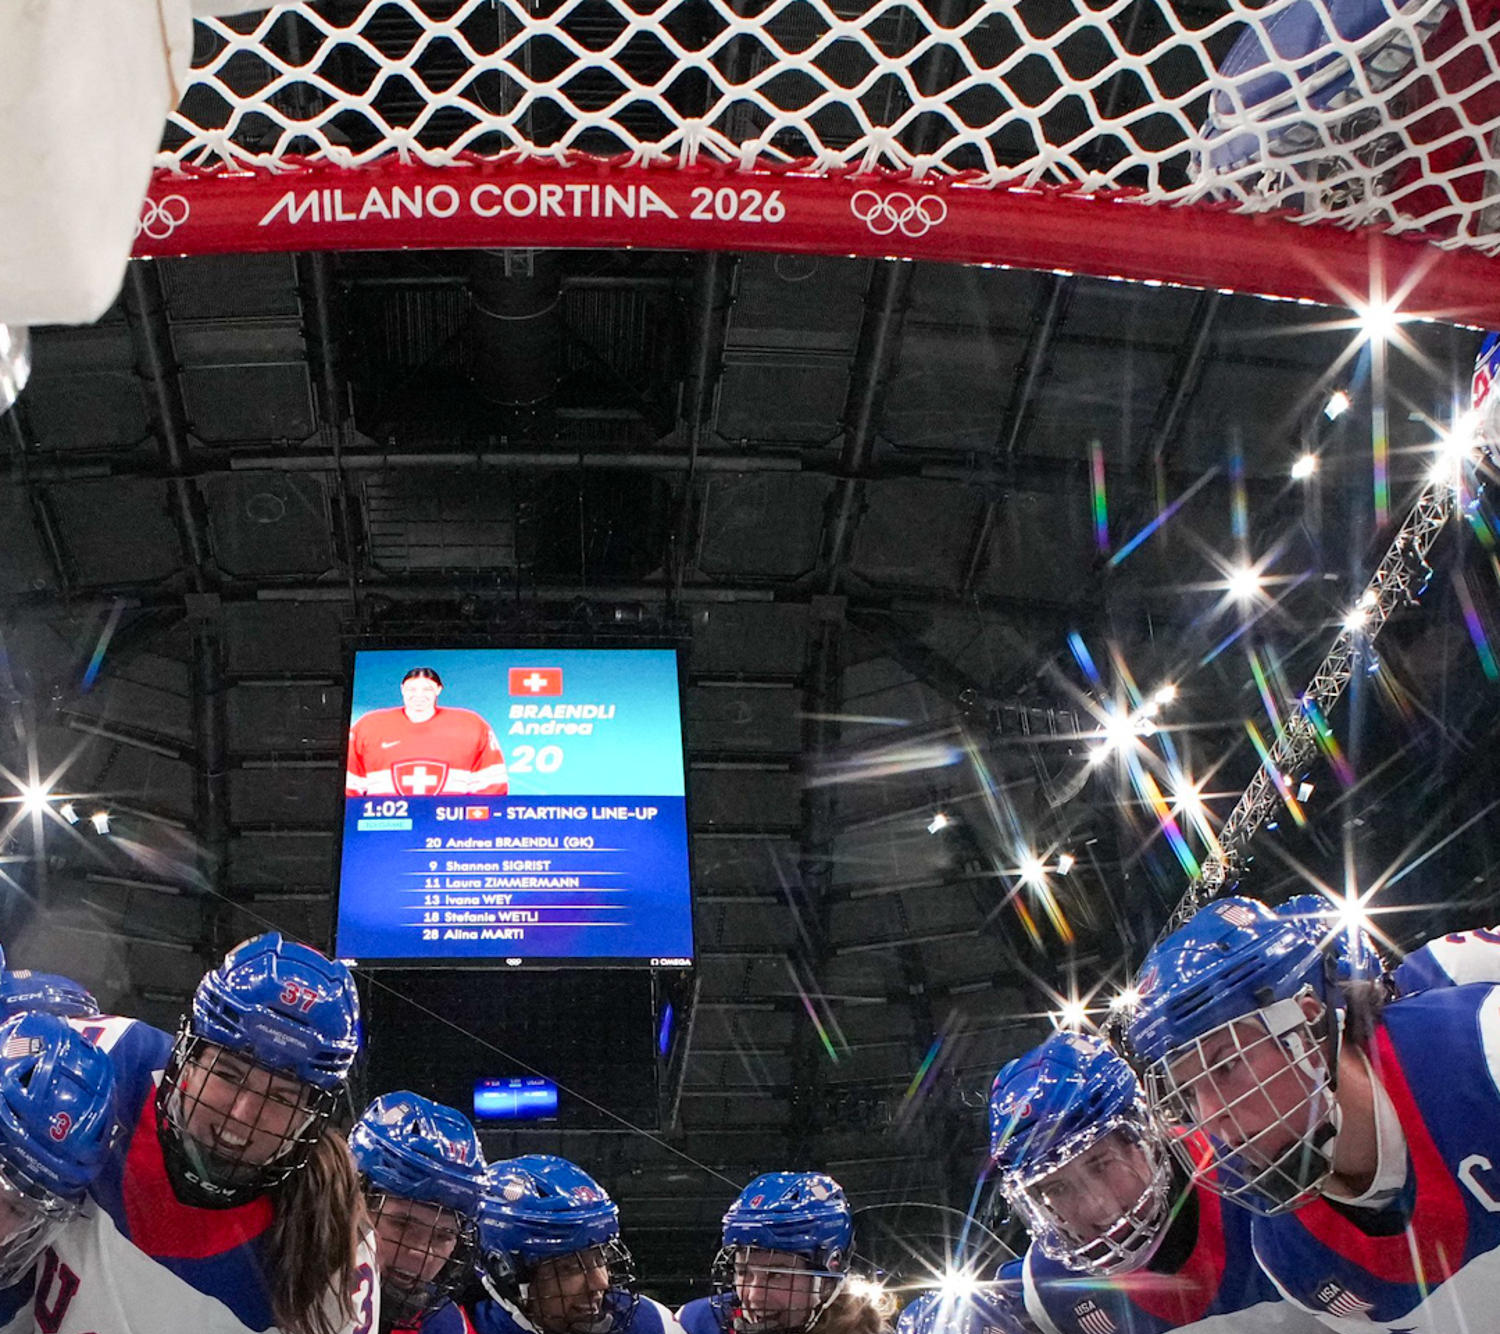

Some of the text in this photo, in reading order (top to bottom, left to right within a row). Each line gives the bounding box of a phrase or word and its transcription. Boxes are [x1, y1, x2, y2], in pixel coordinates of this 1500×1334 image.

[258, 184, 786, 226] MILANO CORTINA 2026
[508, 704, 616, 719] BRAENDLI
[508, 720, 593, 736] Andrea
[508, 745, 564, 774] 20
[363, 800, 409, 817] 1:02
[436, 807, 464, 821] SUI
[506, 807, 588, 821] STARTING
[591, 807, 658, 821] LINE-UP
[425, 836, 594, 850] 20 Andrea BRAENDLI (GK)
[429, 860, 551, 872] 9 Shannon SIGRIST
[424, 877, 579, 889] 11 Laura ZIMMERMANN
[424, 894, 512, 905] 13 Ivana WEY
[423, 911, 539, 923] 18 Stefanie WETLI
[422, 928, 524, 940] 28 Alina MARTI
[280, 981, 318, 1014] 37
[50, 1111, 72, 1142] 3
[1458, 1153, 1500, 1213] C
[1318, 1281, 1342, 1304] USA
[1074, 1299, 1097, 1317] USA
